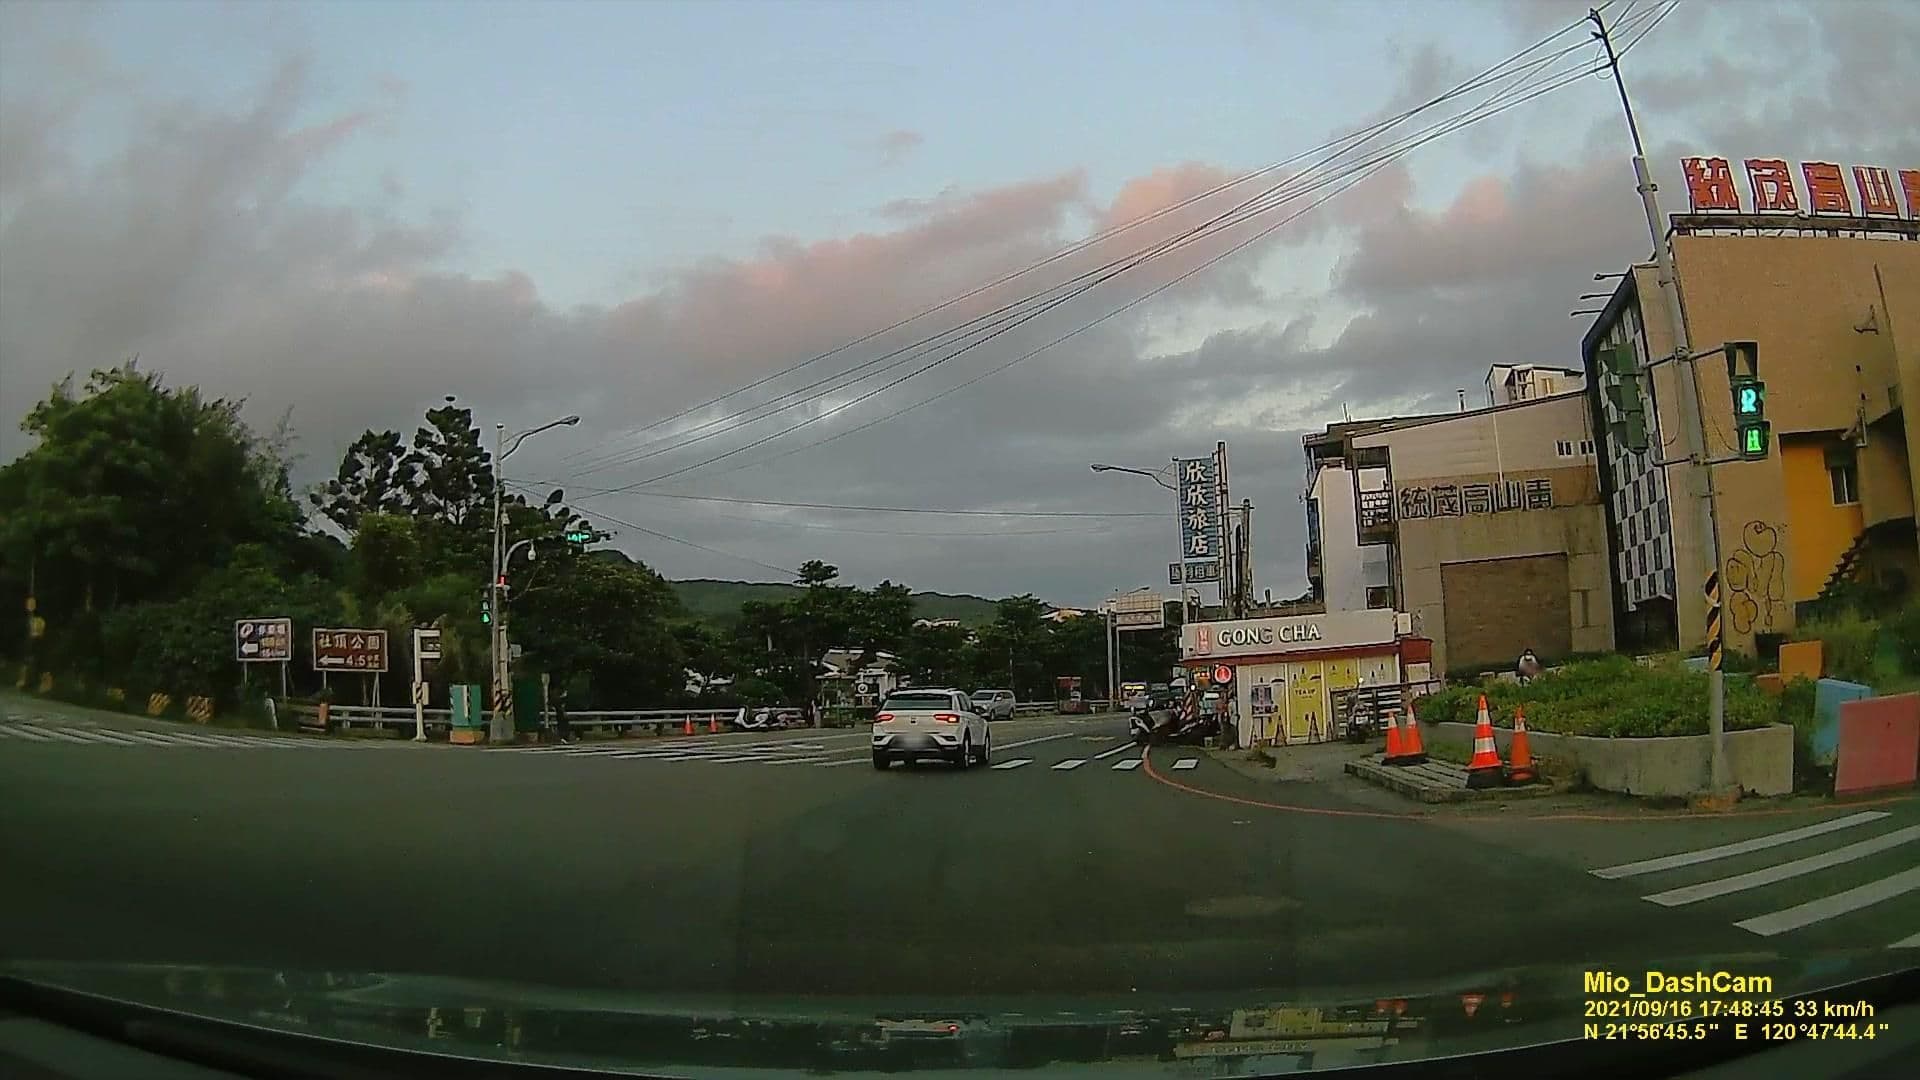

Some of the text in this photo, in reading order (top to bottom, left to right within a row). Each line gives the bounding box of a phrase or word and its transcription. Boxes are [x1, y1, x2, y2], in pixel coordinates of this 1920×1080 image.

[1183, 461, 1210, 557] 欣欣旅店
[319, 633, 380, 650] 社頂公園
[1218, 623, 1322, 646] GONG CHA
[346, 654, 366, 666] 4.5
